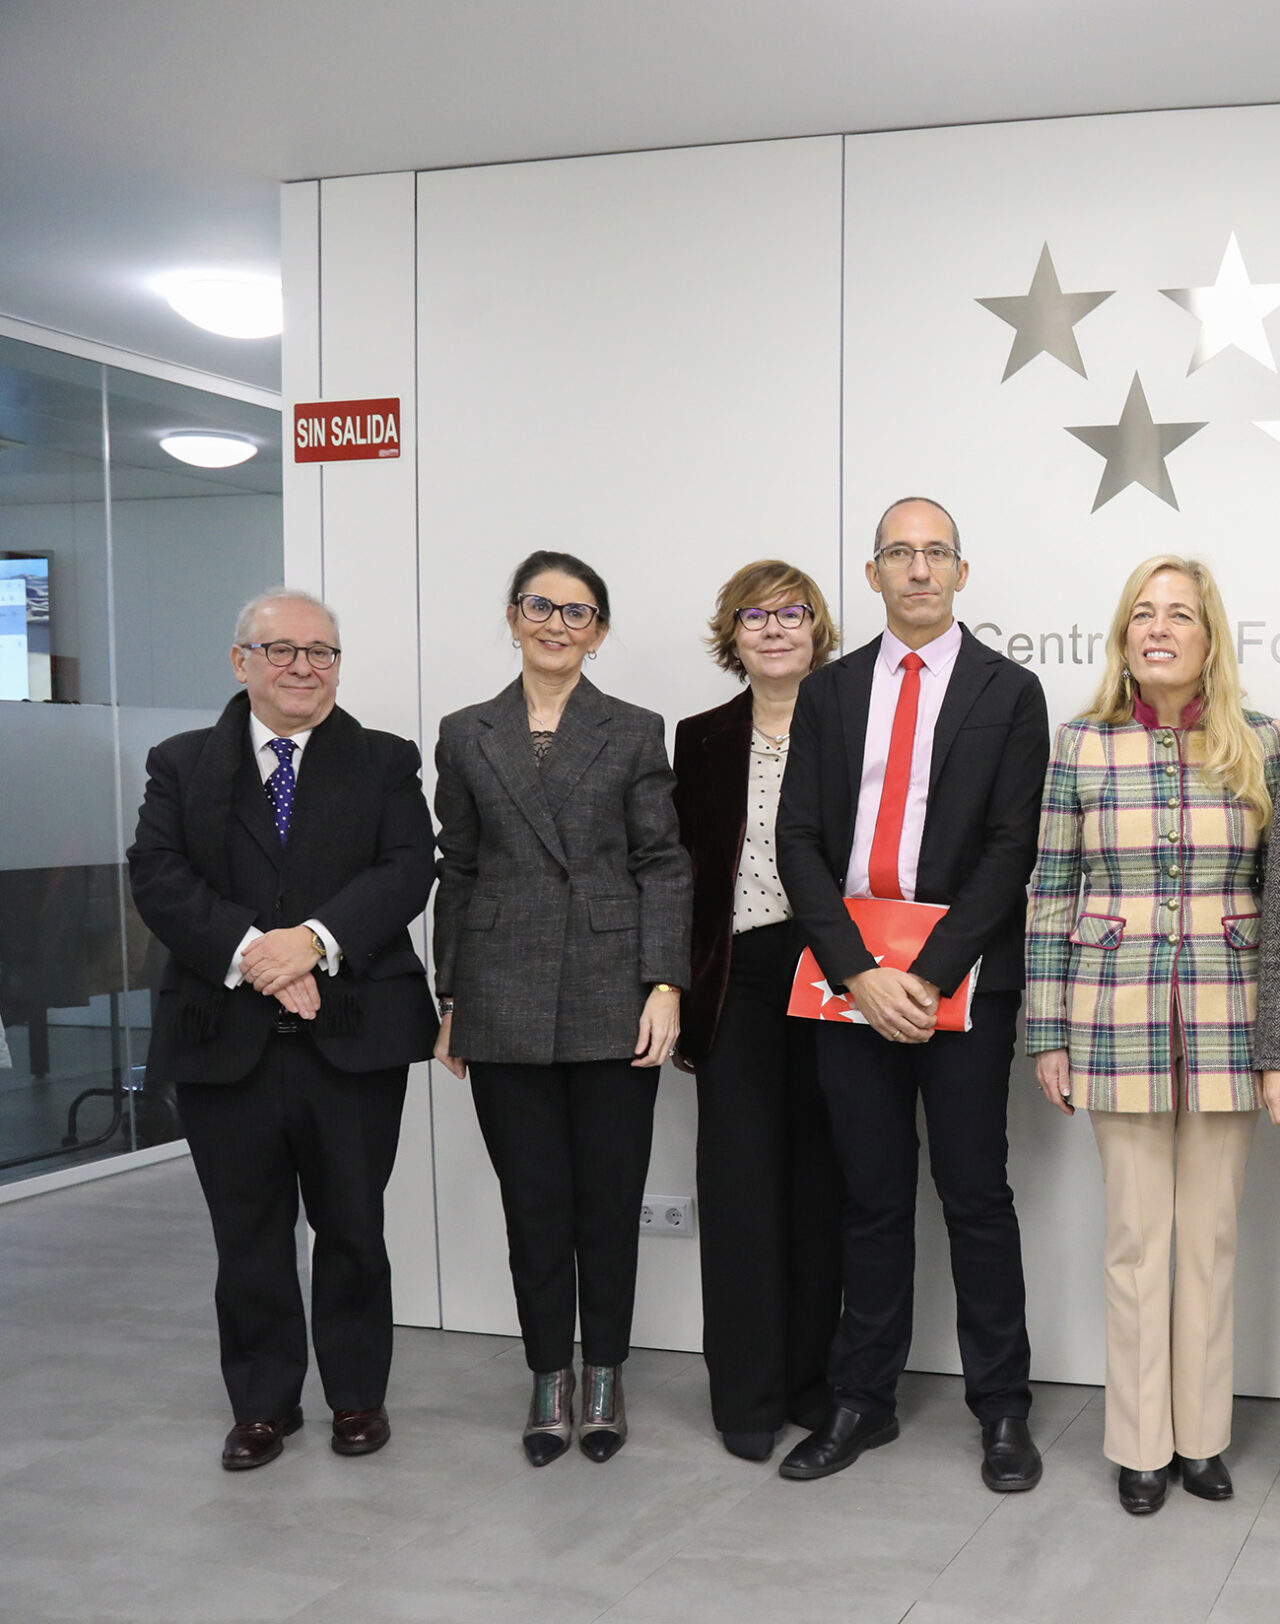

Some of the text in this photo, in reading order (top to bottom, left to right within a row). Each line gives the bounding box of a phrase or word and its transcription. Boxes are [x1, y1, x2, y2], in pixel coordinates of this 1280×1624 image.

[296, 413, 399, 448] SIN SALIDA
[971, 622, 1104, 665] Centr
